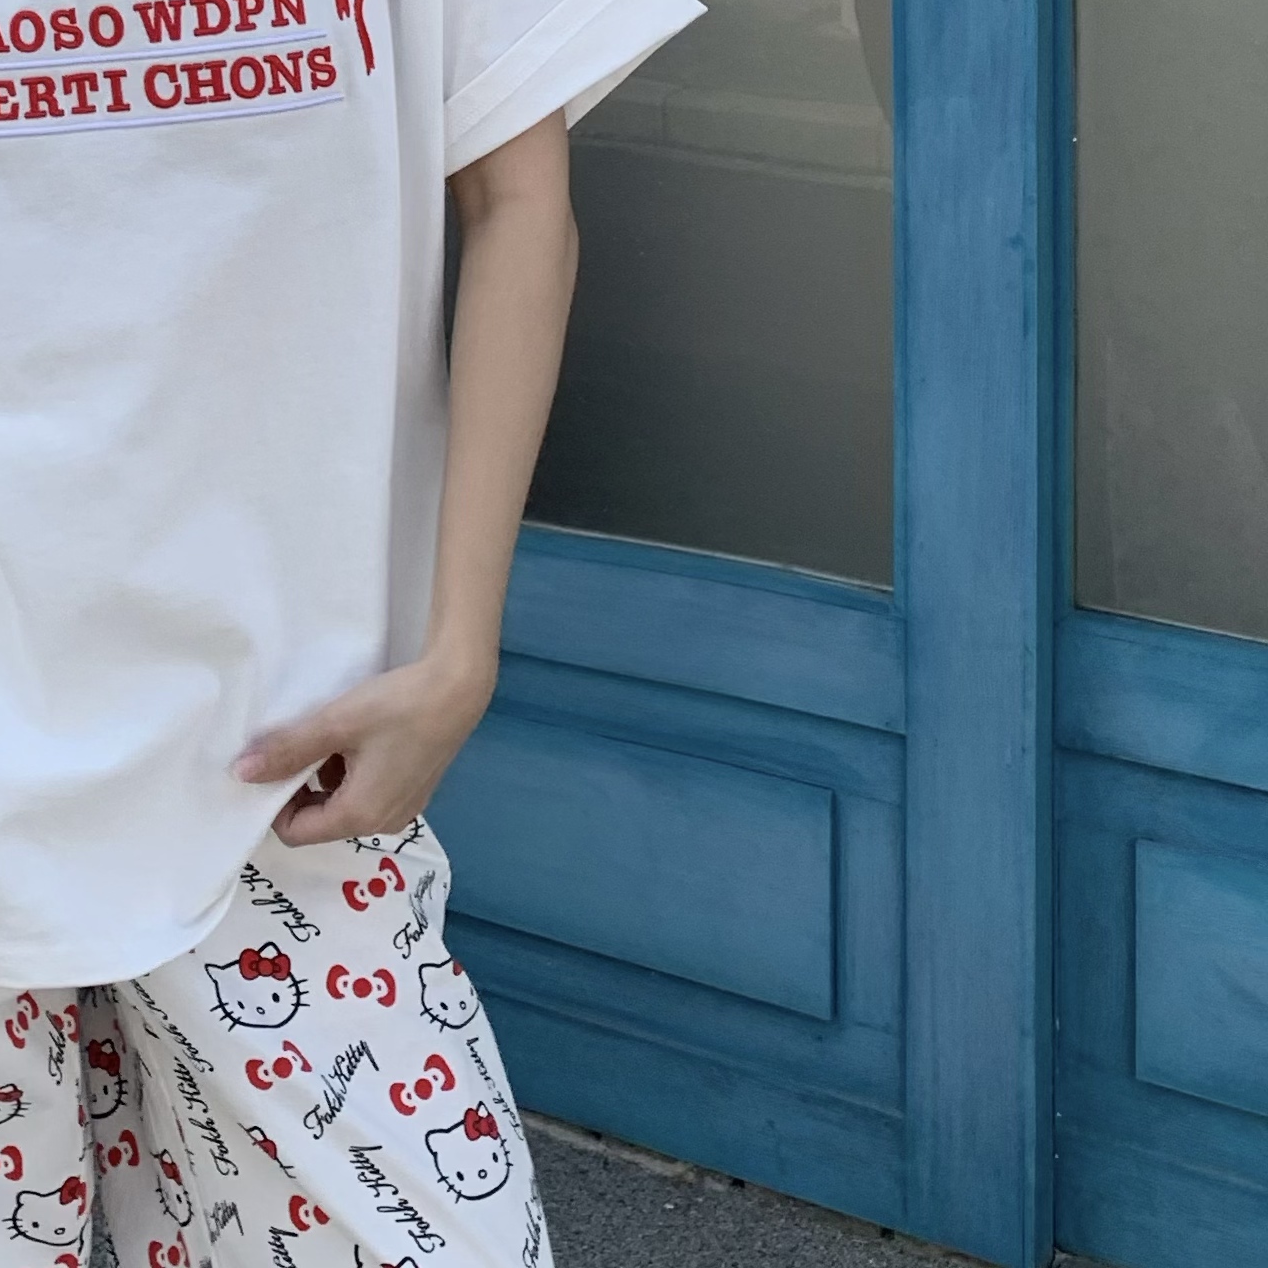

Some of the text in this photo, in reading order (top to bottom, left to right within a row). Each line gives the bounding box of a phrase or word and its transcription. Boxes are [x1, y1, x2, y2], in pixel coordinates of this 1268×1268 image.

[143, 46, 338, 109] CHONS
[328, 1040, 380, 1095] Kitty
[348, 1146, 399, 1198] Kitty
